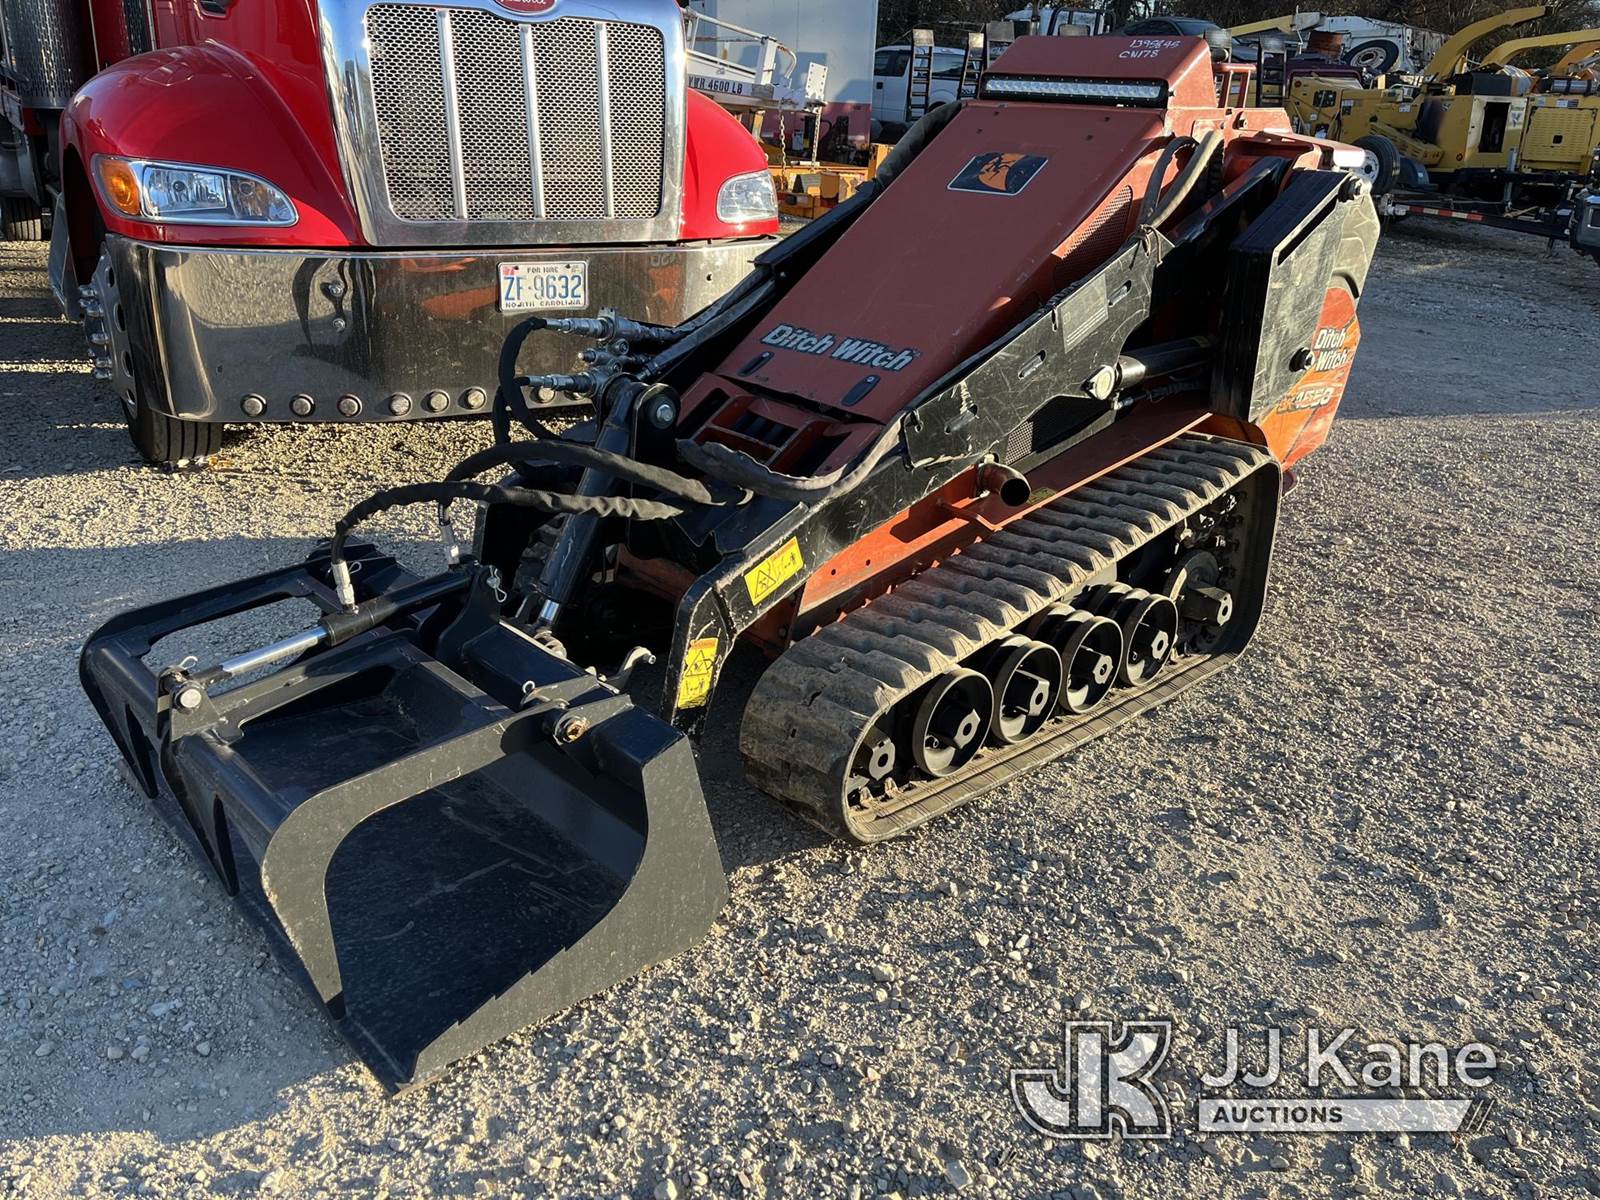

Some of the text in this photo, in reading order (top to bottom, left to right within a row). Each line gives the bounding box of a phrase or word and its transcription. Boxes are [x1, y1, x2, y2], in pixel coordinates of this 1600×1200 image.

[708, 80, 730, 92] 4600
[732, 82, 743, 94] LB
[761, 323, 914, 371] Ditch Witch
[1314, 328, 1346, 350] Ditch
[1315, 349, 1348, 372] Witch
